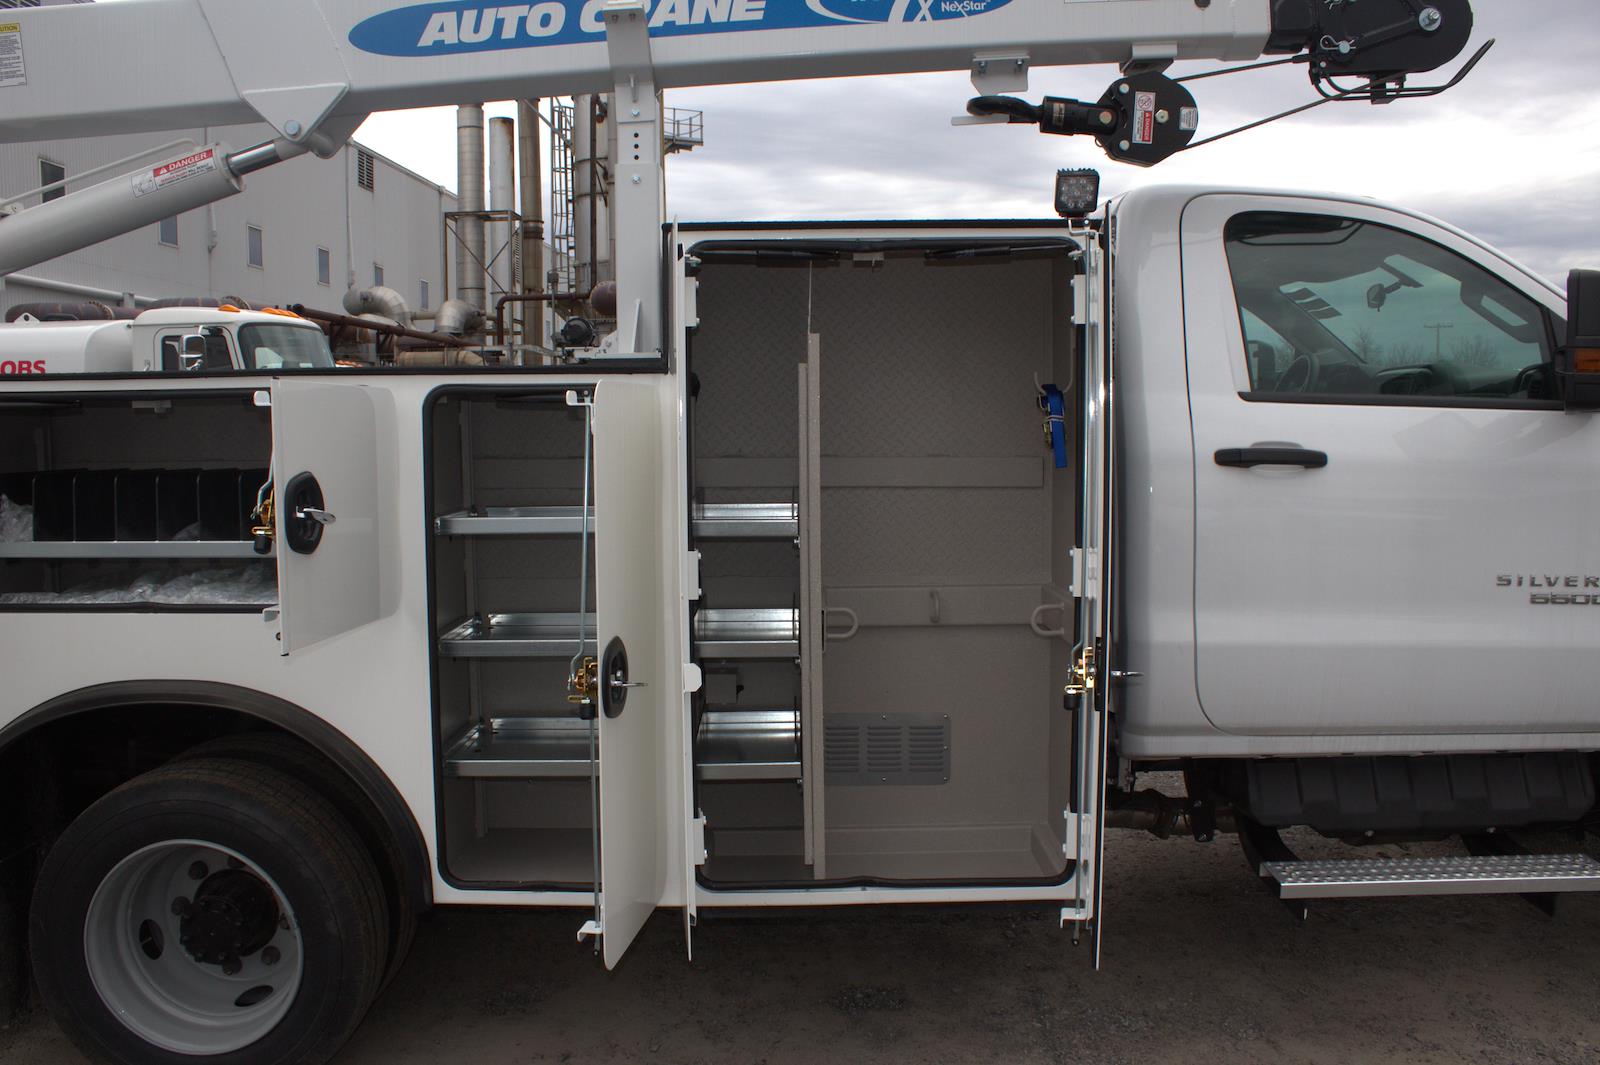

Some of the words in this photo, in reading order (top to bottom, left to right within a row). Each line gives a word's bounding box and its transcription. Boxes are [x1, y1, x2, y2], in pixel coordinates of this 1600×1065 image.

[417, 2, 566, 47] AUTO
[580, 0, 767, 33] CANE
[169, 152, 207, 171] DANGER
[0, 360, 46, 376] OBS
[1496, 574, 1600, 587] SILVER
